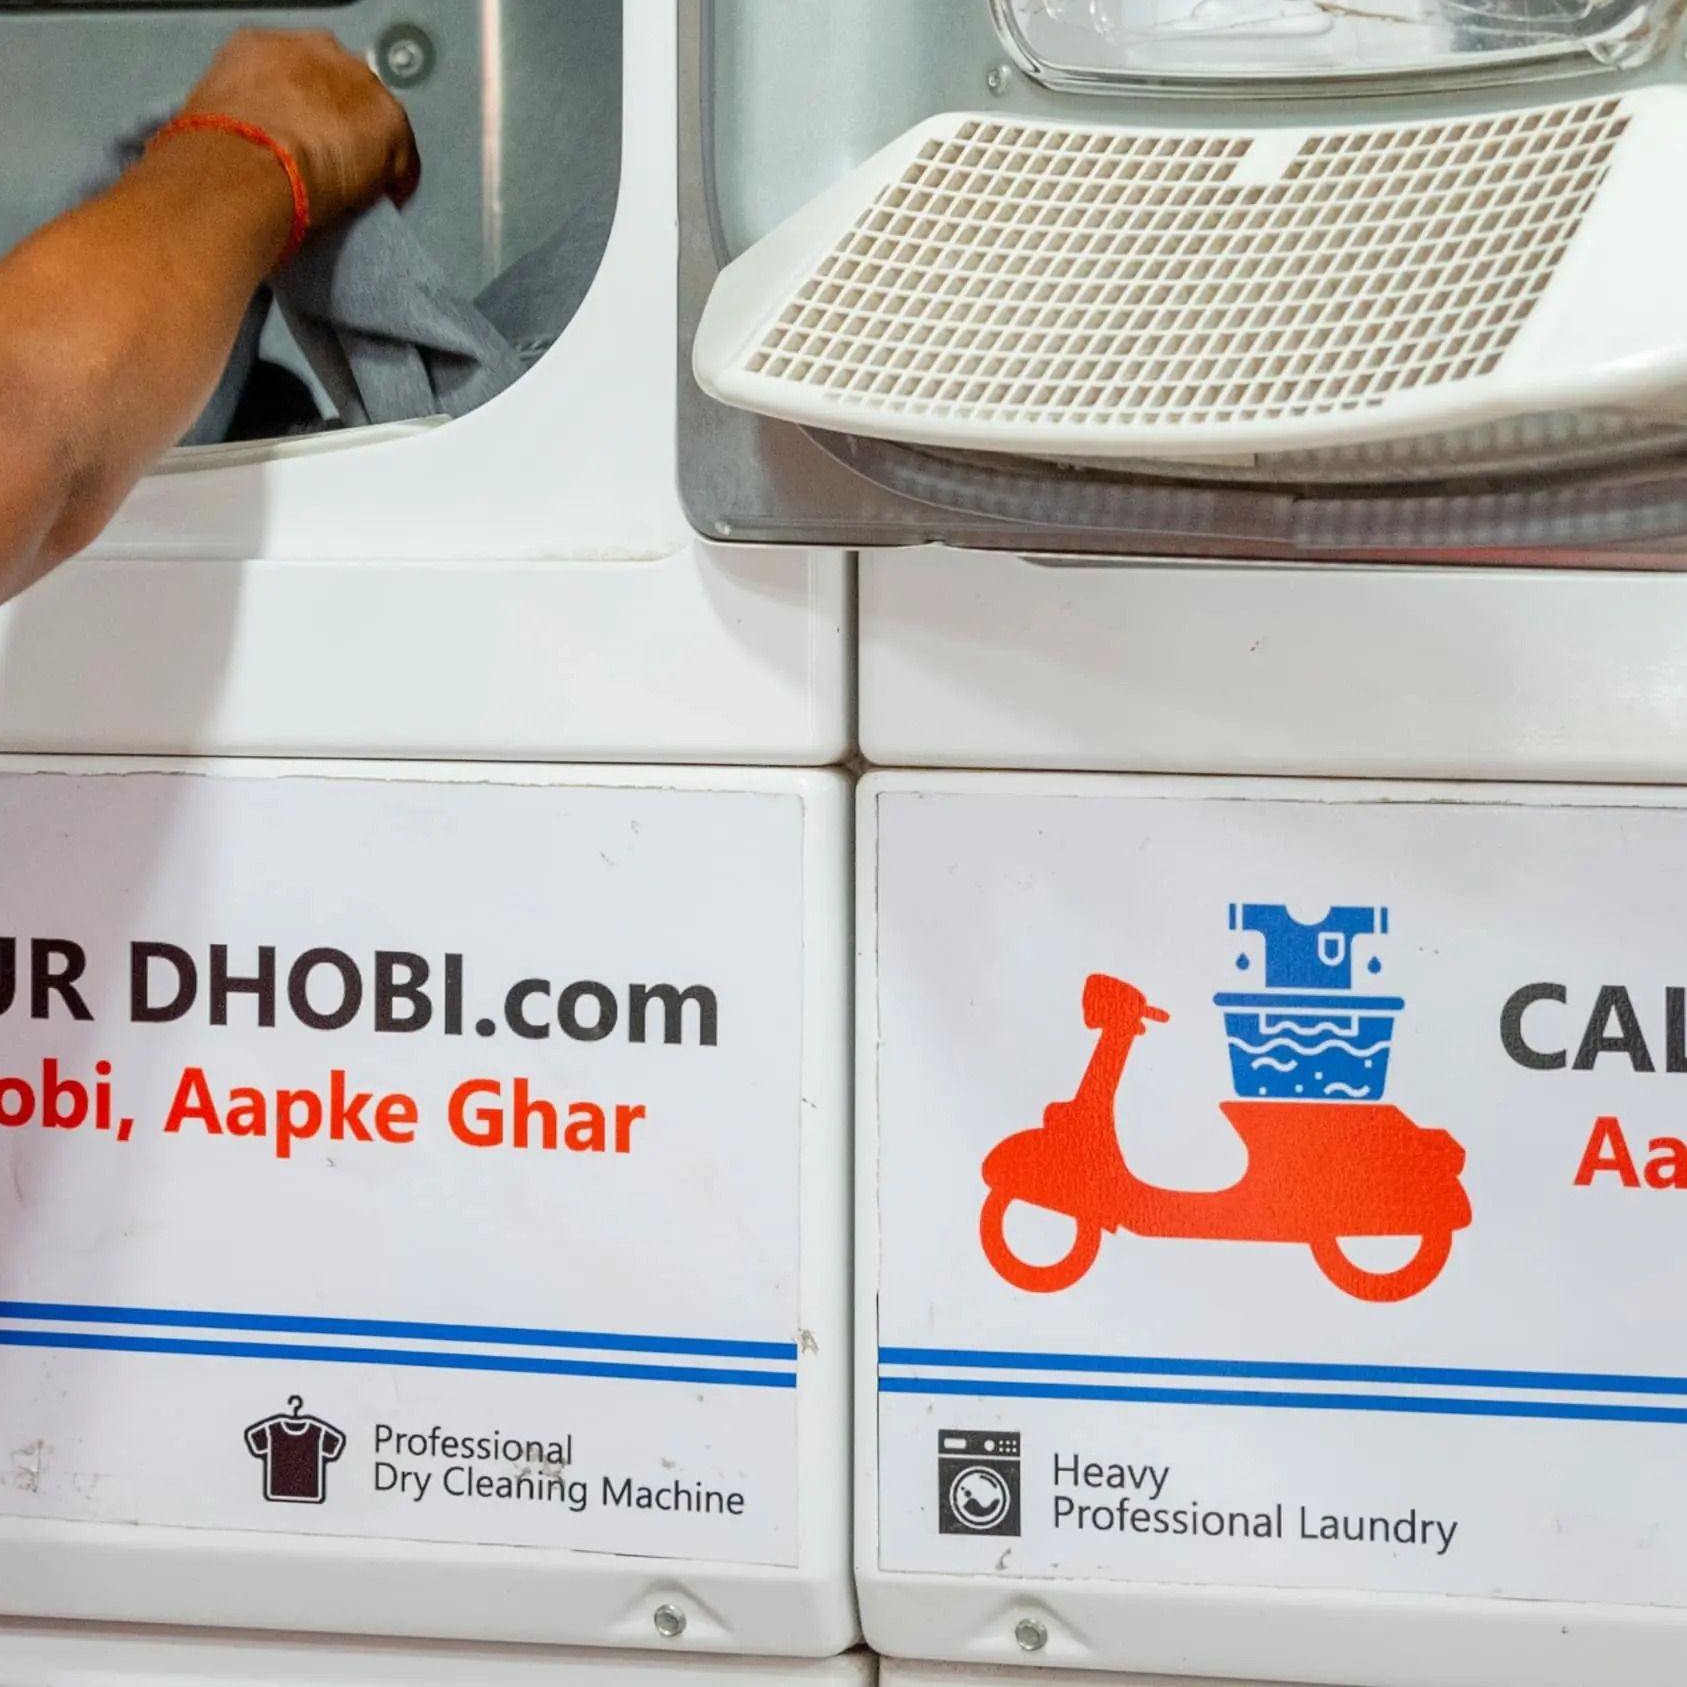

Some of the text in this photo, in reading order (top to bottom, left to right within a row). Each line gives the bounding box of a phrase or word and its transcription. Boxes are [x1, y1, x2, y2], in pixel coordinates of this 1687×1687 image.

[130, 940, 718, 1046] DHOBI.com
[163, 1065, 419, 1160] Aapke
[447, 1076, 646, 1154] Ghar
[1574, 1115, 1687, 1190] Aa
[374, 1423, 573, 1466] Professional
[374, 1461, 745, 1516] Dry Cleaning Machine
[1053, 1453, 1170, 1501] Heavy
[1053, 1495, 1459, 1556] Professional Laundry
